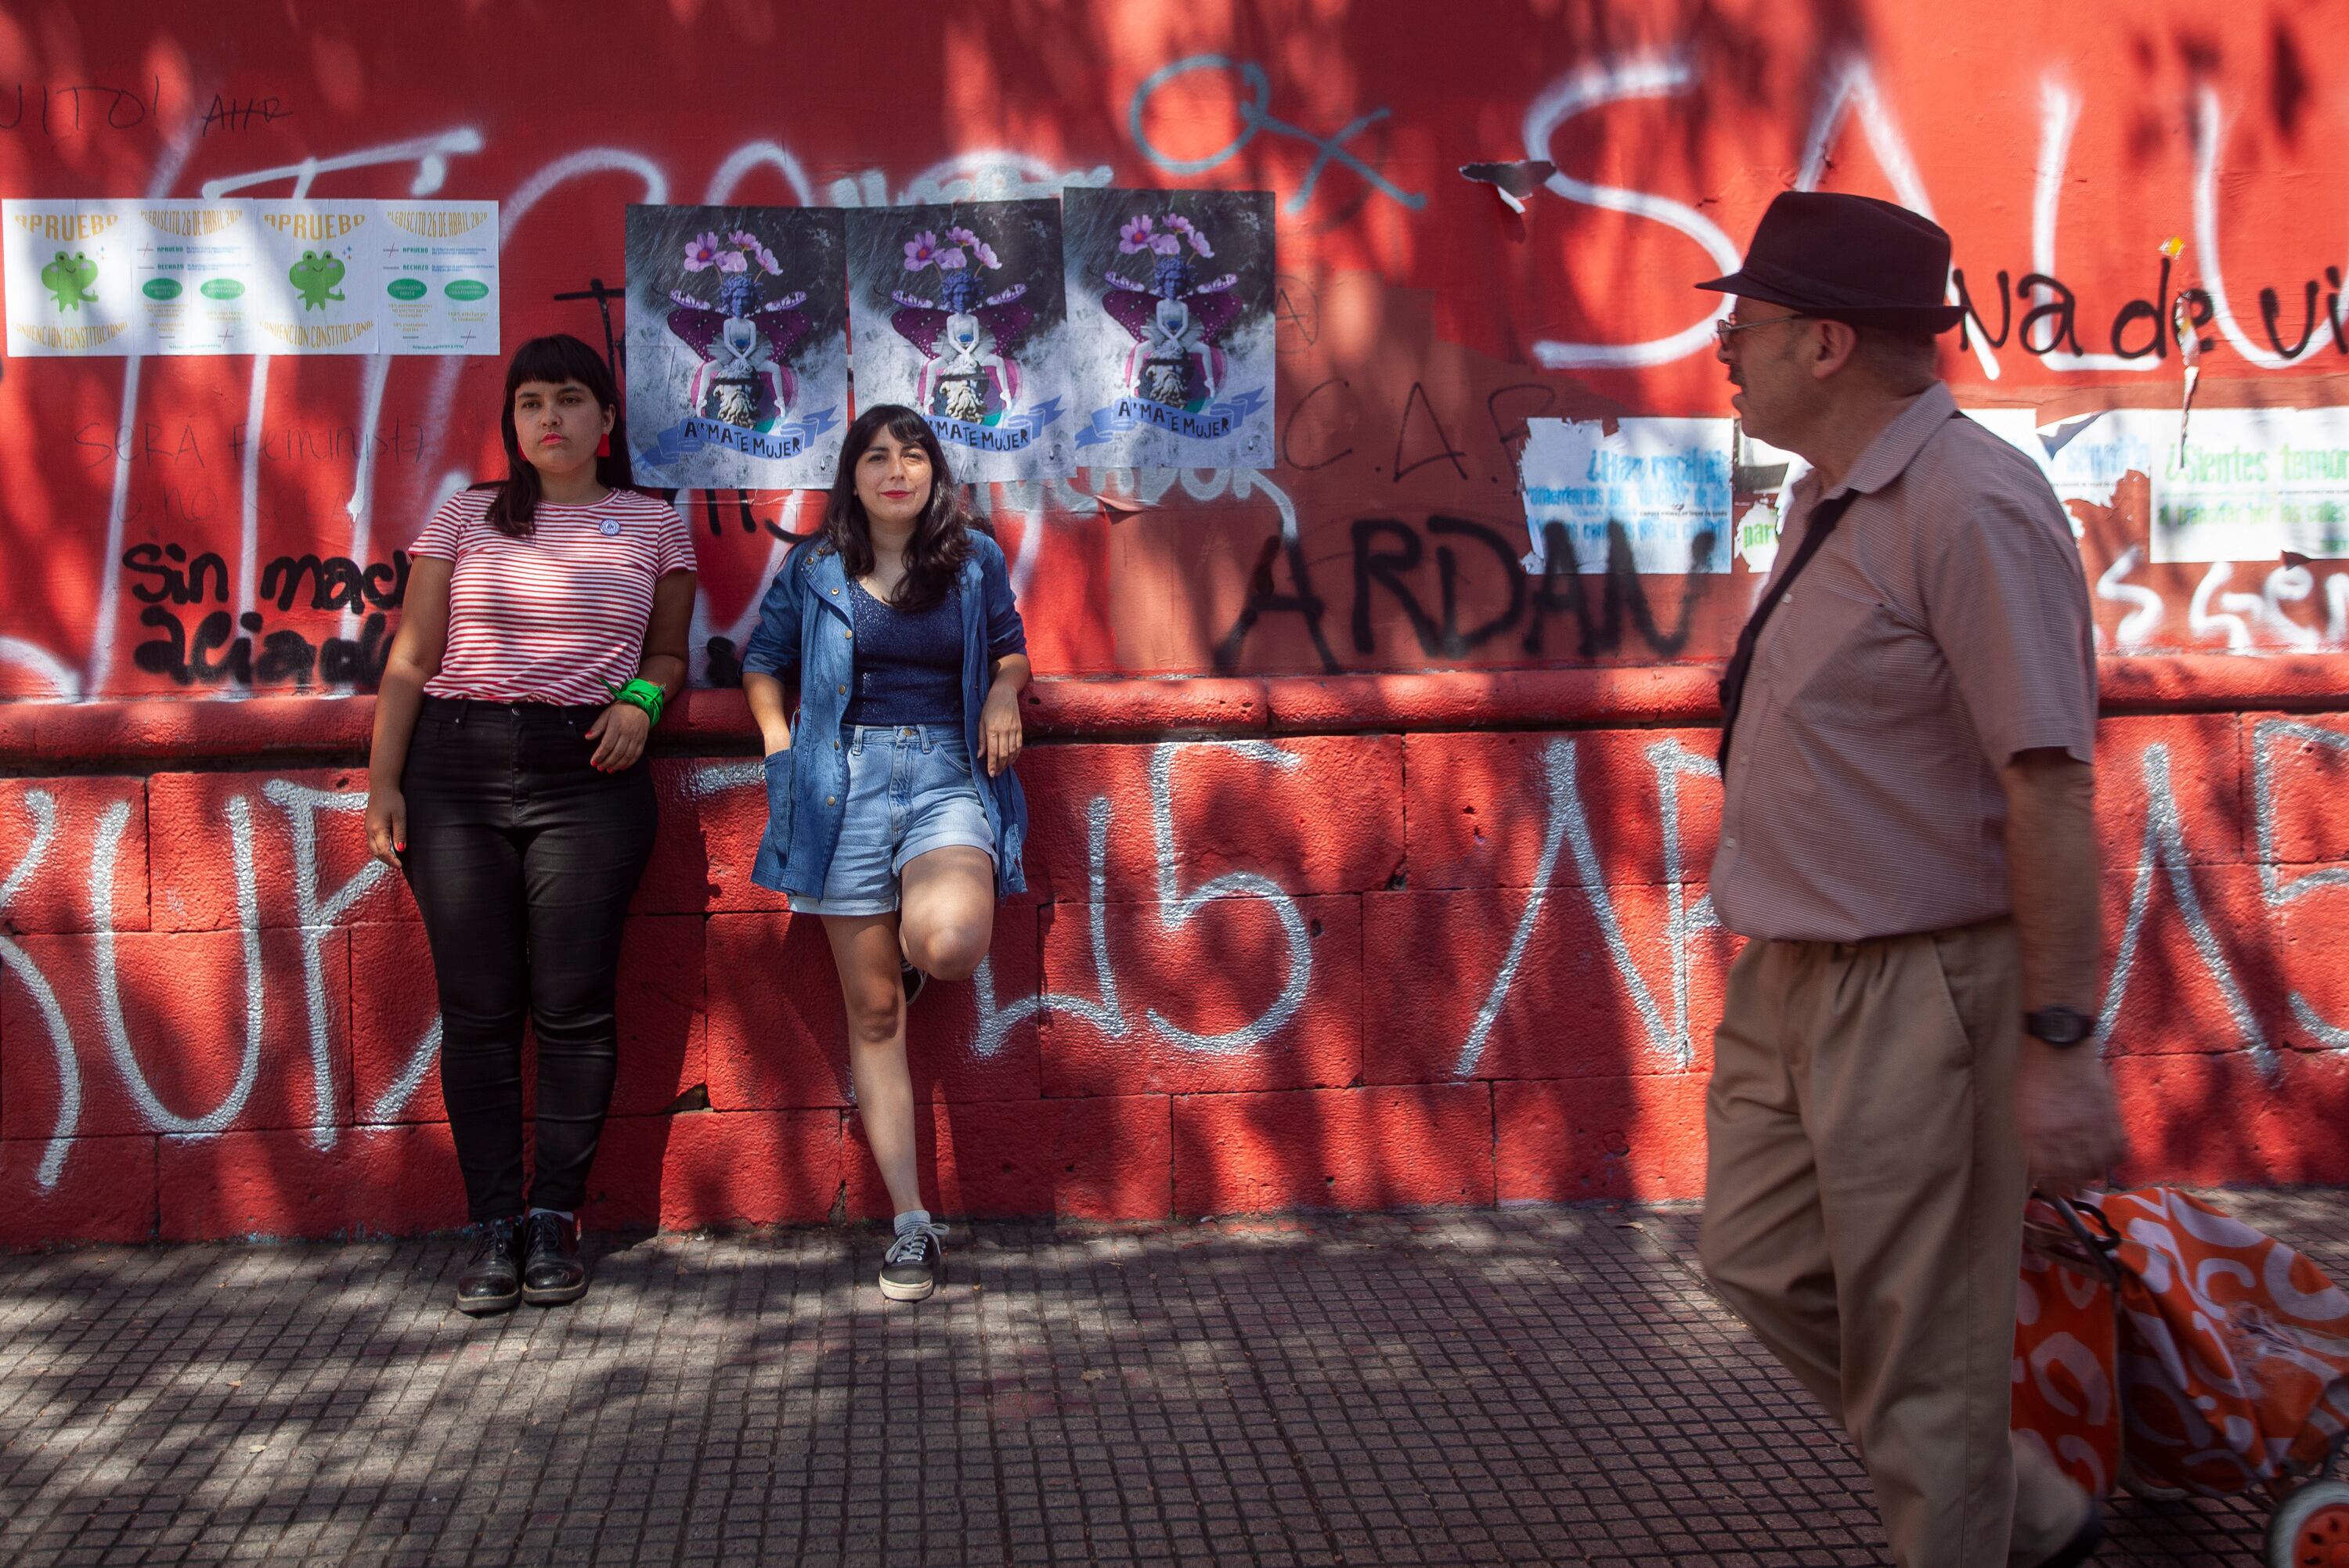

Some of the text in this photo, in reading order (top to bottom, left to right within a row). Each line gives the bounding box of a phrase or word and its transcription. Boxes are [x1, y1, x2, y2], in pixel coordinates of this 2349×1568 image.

[14, 213, 118, 242] APRUEBO
[182, 210, 191, 237] 26
[192, 210, 202, 237] DE
[203, 209, 225, 236] ABRIL
[264, 213, 366, 241] APRUEBO
[387, 210, 427, 236] PLEBISCITO
[428, 211, 437, 238] 26
[438, 211, 448, 238] DE
[448, 211, 471, 236] ABRIL
[311, 319, 375, 348] CONSTITUCIONAL
[981, 428, 1028, 452] MUJER
[1183, 416, 1229, 439] MUJER
[752, 437, 800, 459] MUJER
[1744, 523, 1778, 550] par
[122, 542, 229, 605] Sin
